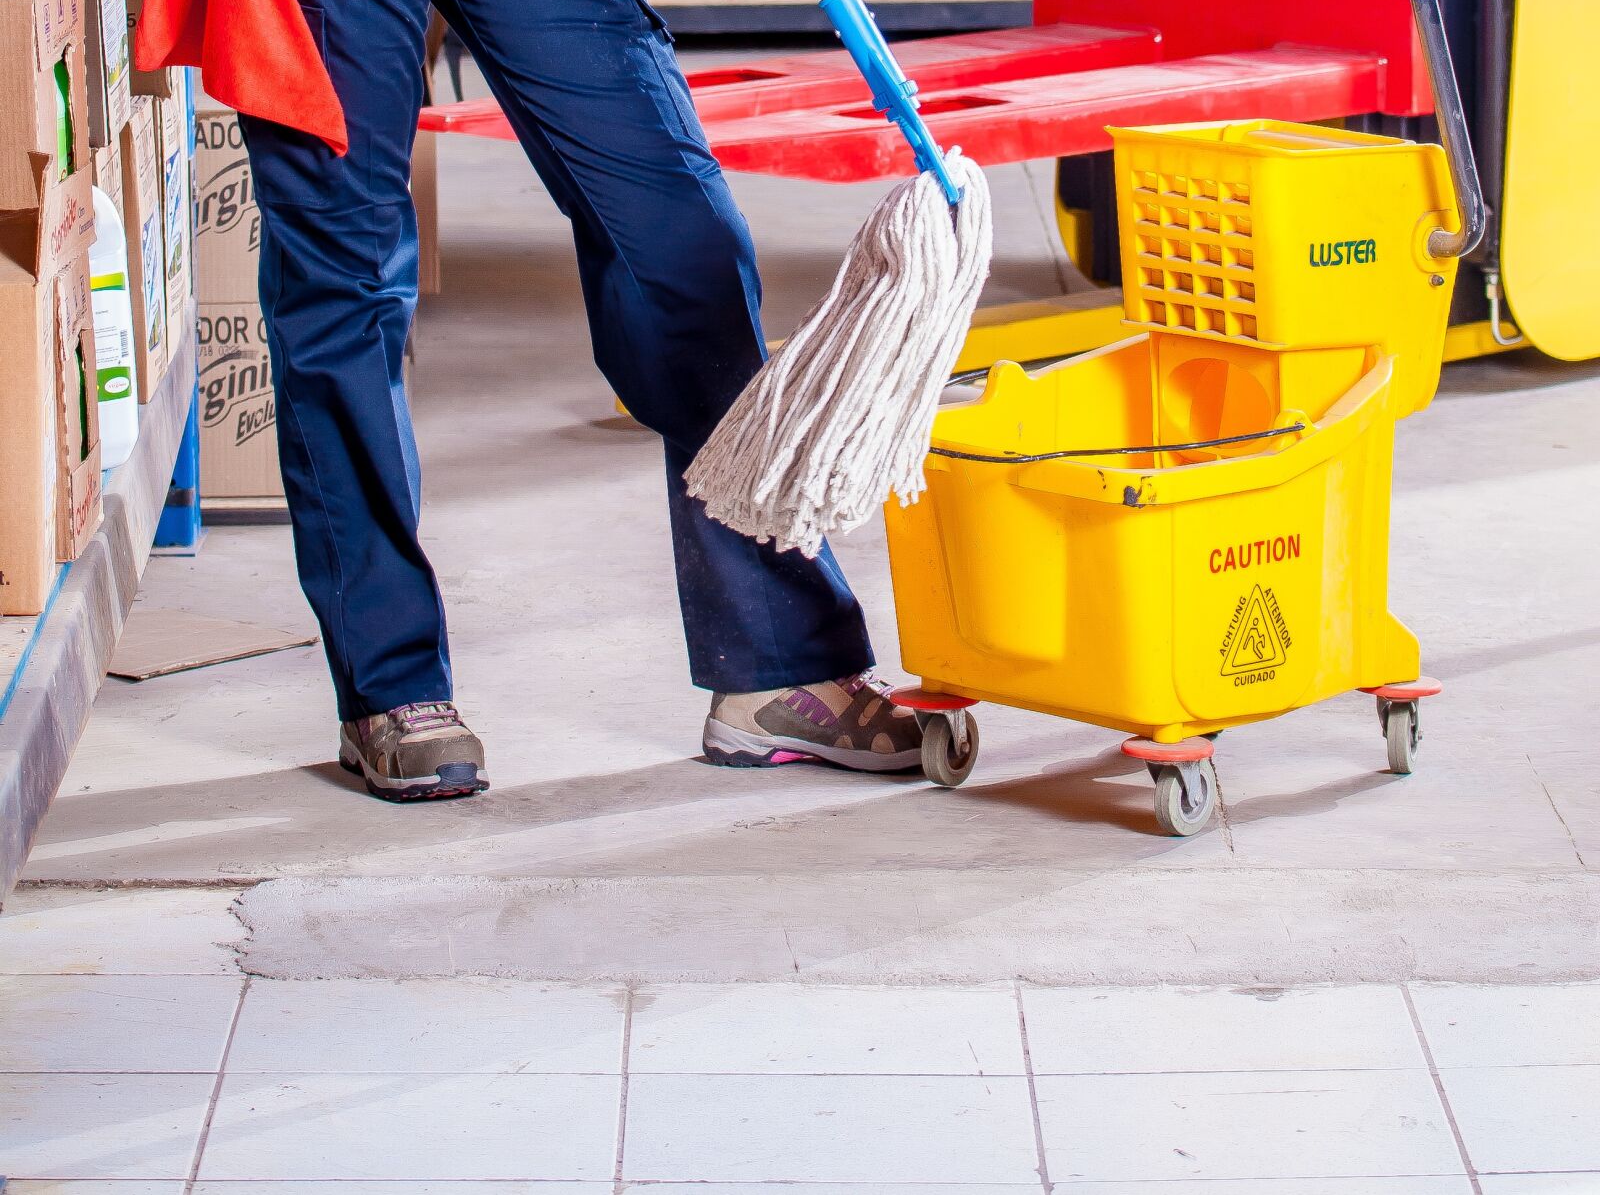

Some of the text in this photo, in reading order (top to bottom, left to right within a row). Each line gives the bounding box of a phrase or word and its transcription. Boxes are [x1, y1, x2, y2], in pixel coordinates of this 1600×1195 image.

[1309, 238, 1376, 268] LUSTER
[199, 354, 273, 422] gini
[1209, 533, 1301, 574] CAUTION
[1218, 595, 1247, 657] ACHTUNG
[1264, 587, 1293, 649] ATTENTION
[1233, 669, 1276, 687] CUIDADO
